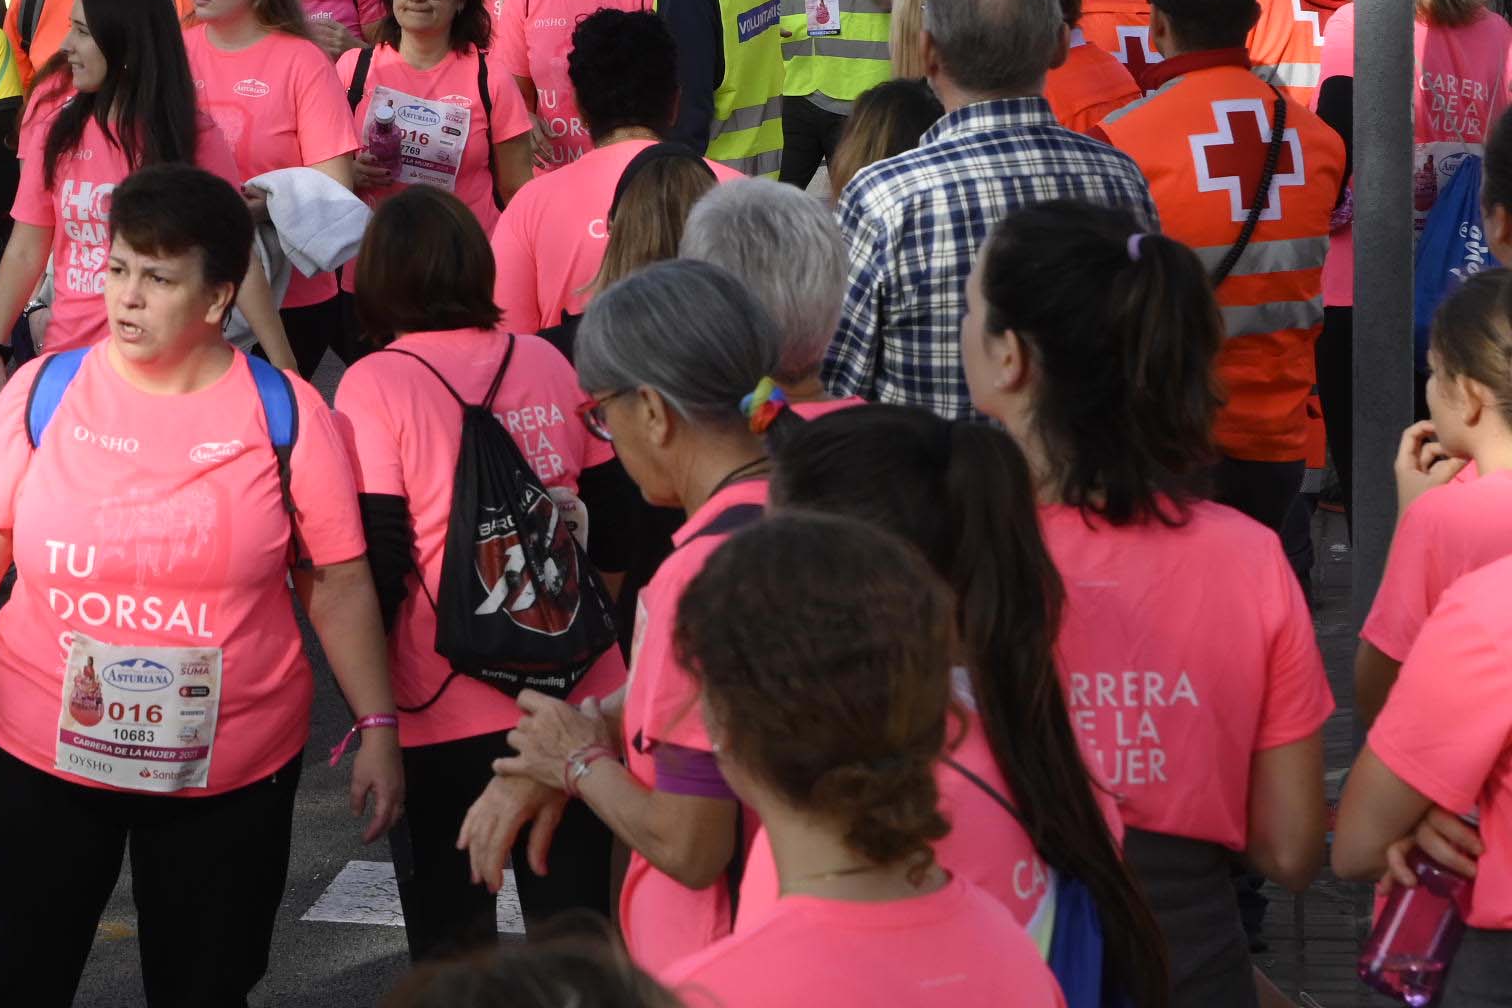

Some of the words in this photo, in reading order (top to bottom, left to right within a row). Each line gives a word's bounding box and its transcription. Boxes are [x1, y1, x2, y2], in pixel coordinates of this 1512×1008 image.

[534, 18, 566, 28] OYSHO
[738, 2, 784, 35] VOLUNTARIS
[66, 268, 108, 294] CHIC
[73, 423, 141, 455] OYSHO
[524, 436, 553, 456] LA
[44, 540, 96, 579] TU
[49, 588, 214, 639] DORSAL
[107, 668, 168, 684] ASTURIANA
[180, 666, 209, 676] SUMA
[525, 674, 566, 689] Bowling
[1070, 671, 1199, 707] RRERA
[107, 701, 164, 724] 016
[113, 728, 155, 743] 10683
[1116, 713, 1161, 746] LA
[73, 736, 114, 753] CARRERA
[114, 747, 128, 755] DE
[129, 748, 142, 757] LA
[143, 750, 176, 759] MUJER
[69, 752, 113, 775] OYSHO
